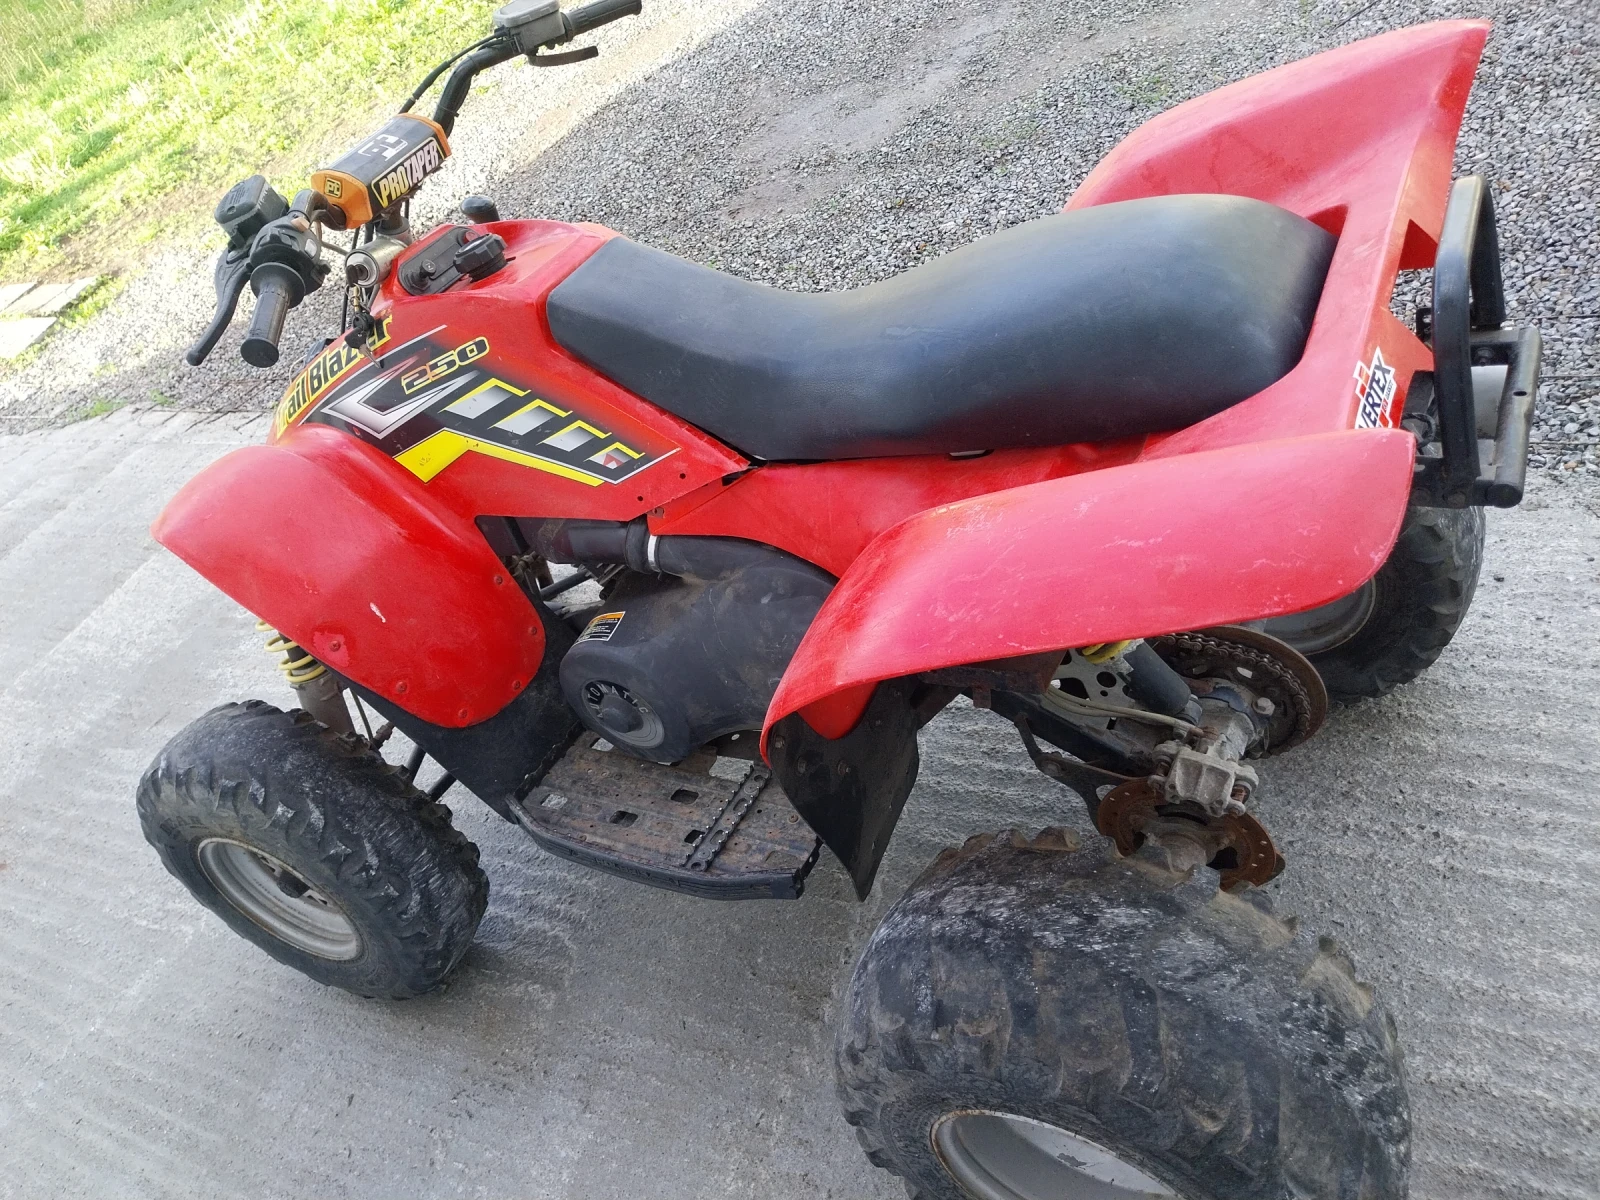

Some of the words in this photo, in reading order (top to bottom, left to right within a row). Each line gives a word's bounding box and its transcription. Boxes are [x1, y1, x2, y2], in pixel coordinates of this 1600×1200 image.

[379, 141, 439, 206] PROTAPER
[276, 373, 308, 437] Trail
[308, 315, 392, 400] Blazr
[401, 336, 490, 395] 250
[587, 683, 649, 720] AUTOMATIC
